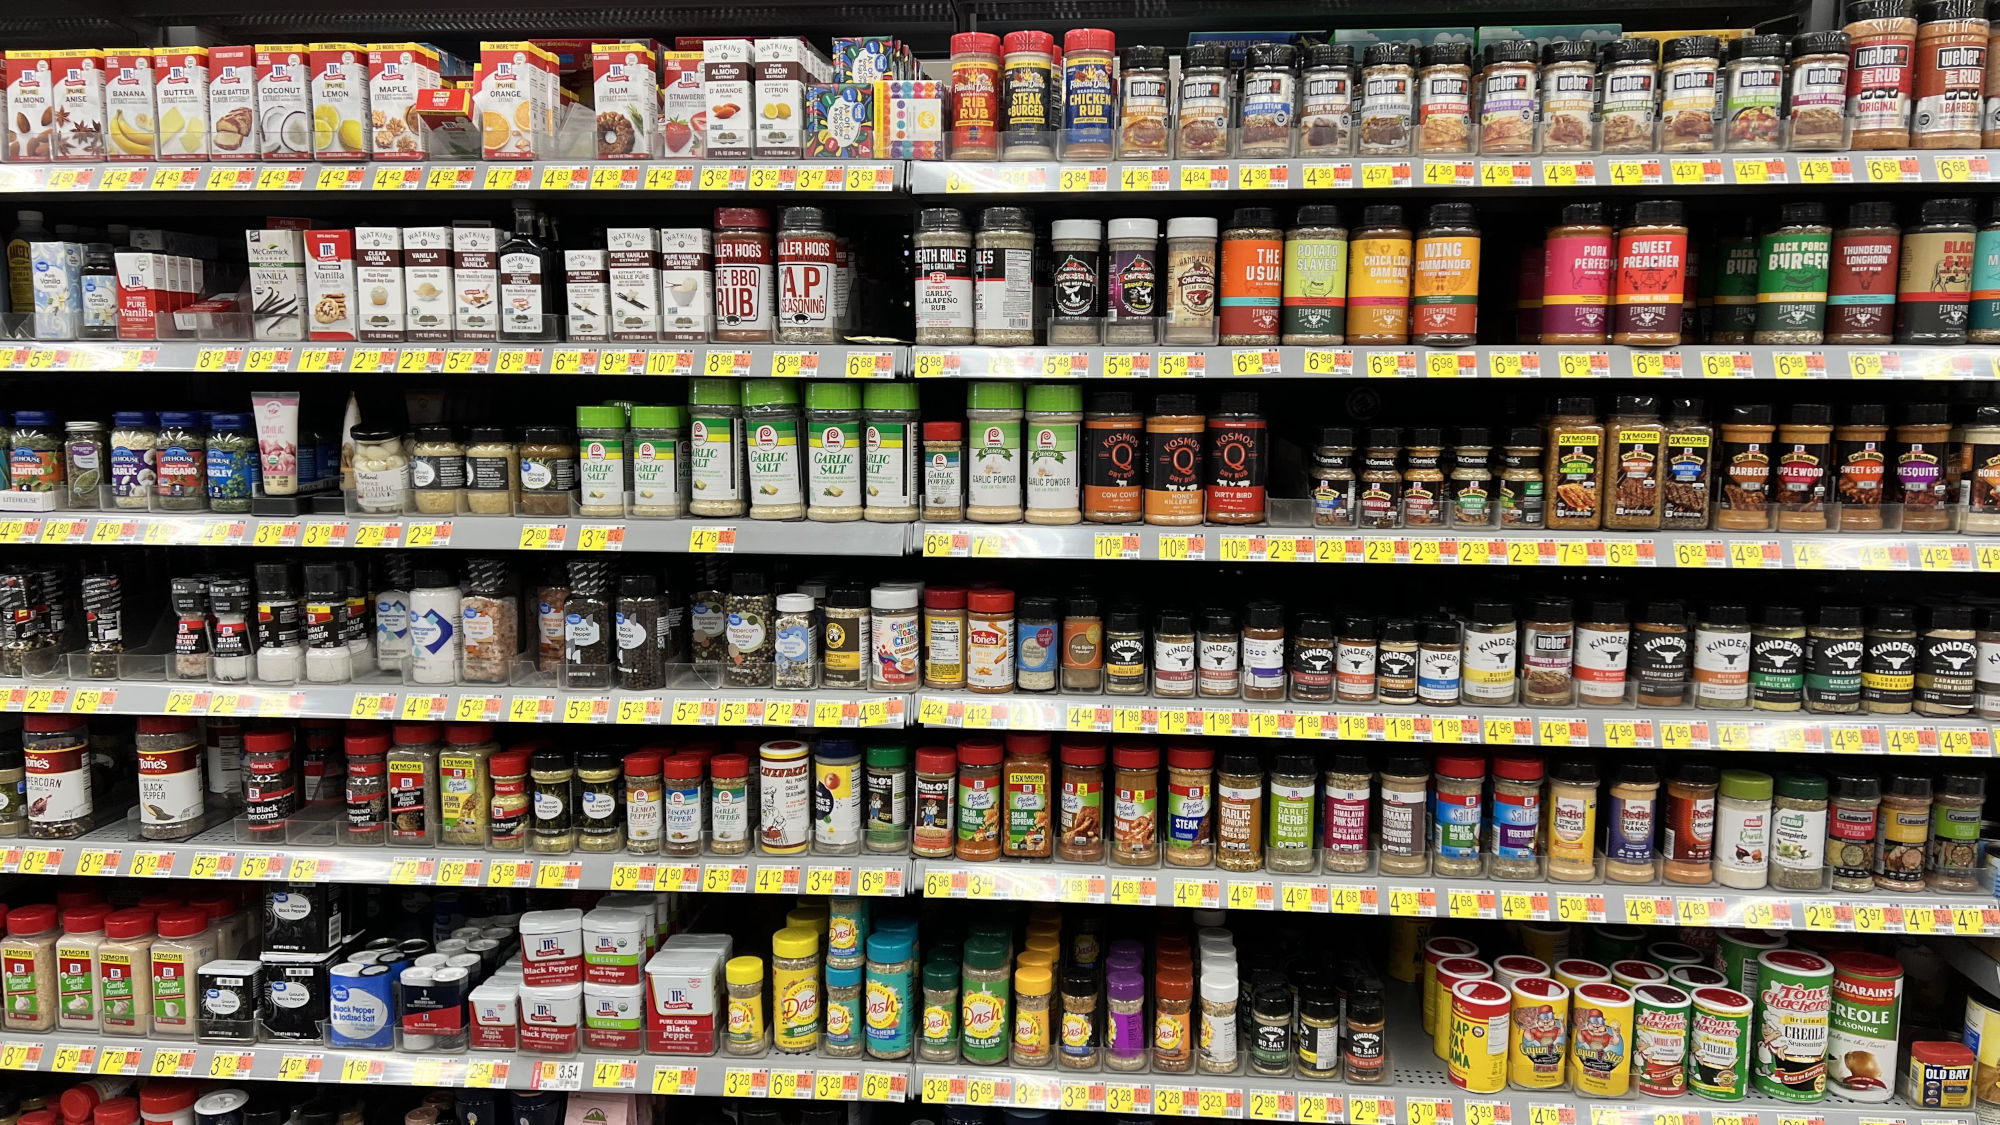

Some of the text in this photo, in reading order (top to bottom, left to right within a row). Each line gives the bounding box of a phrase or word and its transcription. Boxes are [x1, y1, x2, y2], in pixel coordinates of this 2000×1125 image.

[707, 44, 742, 56] WATKINS
[760, 44, 793, 56] WATKINS
[1859, 49, 1898, 65] weber
[1941, 48, 1978, 67] weber
[711, 67, 740, 75] ALMOND
[764, 67, 788, 75] LEMON
[1875, 69, 1900, 82] RUB
[1960, 69, 1981, 83] RUB
[1810, 70, 1840, 85] weber
[1133, 83, 1159, 96] weber
[1310, 81, 1337, 95] weber
[1432, 80, 1460, 94] weber
[322, 90, 349, 98] LEMON
[489, 90, 521, 98] ORANGE
[1012, 92, 1041, 105] STEAK
[962, 97, 986, 108] RIB
[1070, 94, 1111, 106] CHICKEN
[1079, 105, 1102, 117] RUB
[1859, 102, 1897, 112] ORIGINAL
[960, 108, 989, 119] RUB
[359, 232, 393, 242] WATKINS
[612, 233, 645, 242] WATKINS
[252, 248, 288, 256] McCormick
[735, 244, 761, 257] HOGS
[804, 242, 829, 256] HOGS
[1297, 245, 1338, 256] POTATO
[1424, 242, 1461, 258] WING
[1584, 245, 1607, 257] PORK
[1632, 241, 1672, 254] SWEET
[1773, 243, 1798, 251] BACK
[1843, 245, 1892, 255] THUNDERING
[940, 249, 966, 263] RILES
[1256, 249, 1279, 263] THE
[1364, 255, 1391, 266] CHICA
[1623, 255, 1679, 268] PREACHER
[1768, 253, 1829, 270] BURGER
[1846, 255, 1888, 265] LONGHORN
[1297, 258, 1338, 271] SLAYER
[1417, 259, 1471, 270] COMMANDER
[257, 272, 288, 281] VANILLA
[314, 271, 344, 279] Vanilla
[732, 268, 757, 287] BBQ
[1370, 267, 1390, 278] BAM
[782, 299, 824, 313] SEASONING
[120, 308, 154, 318] Vanilla
[1103, 435, 1139, 448] KOSMOS
[1215, 434, 1255, 447] KOSMOS
[1560, 435, 1571, 444] 3X
[1621, 433, 1631, 441] 3X
[750, 452, 788, 463] GARLIC
[814, 453, 853, 464] GARLIC
[160, 466, 198, 476] OREGANO
[582, 463, 614, 475] GARLIC
[756, 463, 780, 473] SALT
[820, 464, 846, 474] SALT
[1840, 466, 1864, 474] SWEET
[586, 471, 607, 481] SALT
[928, 471, 953, 480] GARLIC
[993, 474, 1016, 484] POWDER
[927, 477, 955, 486] POWDER
[1214, 491, 1252, 499] DIRTY BIRD
[972, 634, 997, 644] Tone's
[1537, 636, 1570, 649] weber
[139, 758, 168, 770] Tone's
[1024, 774, 1043, 782] MORE
[143, 783, 163, 791] BLACK
[143, 791, 166, 800] PEPPER
[256, 804, 278, 813] Black
[714, 807, 739, 815] GARLIC
[961, 808, 976, 817] SALAD
[1221, 809, 1251, 819] GARLIC
[1555, 808, 1585, 819] RedHot
[630, 812, 657, 820] PEPPER
[962, 816, 983, 824] SUPREME
[1278, 815, 1303, 824] HERB
[1454, 809, 1471, 822] Salt
[1838, 813, 1872, 822] Cuisinart
[1175, 818, 1198, 829] STEAK
[1334, 817, 1360, 826] PINK SALT
[1836, 823, 1872, 831] ULTIMATE
[1449, 824, 1471, 833] GARLIC
[1776, 829, 1808, 839] Complete
[1459, 832, 1473, 840] HERB
[830, 926, 856, 942] Dash
[524, 964, 578, 974] Black Pepper
[158, 986, 181, 995] Powder
[333, 1005, 375, 1016] Black Pepper
[963, 1004, 1001, 1025] Dash
[339, 1013, 375, 1022] Iodized Salt
[1790, 1016, 1823, 1025] Original
[666, 1025, 690, 1033] Black
[1834, 1018, 1879, 1034] SEASONING
[1784, 1026, 1825, 1039] CREOLE
[1787, 1040, 1823, 1048] Seasoning
[1520, 1044, 1547, 1056] Cajun
[559, 1065, 578, 1078] 3.54
[1925, 1068, 1968, 1080] OLD BAY
